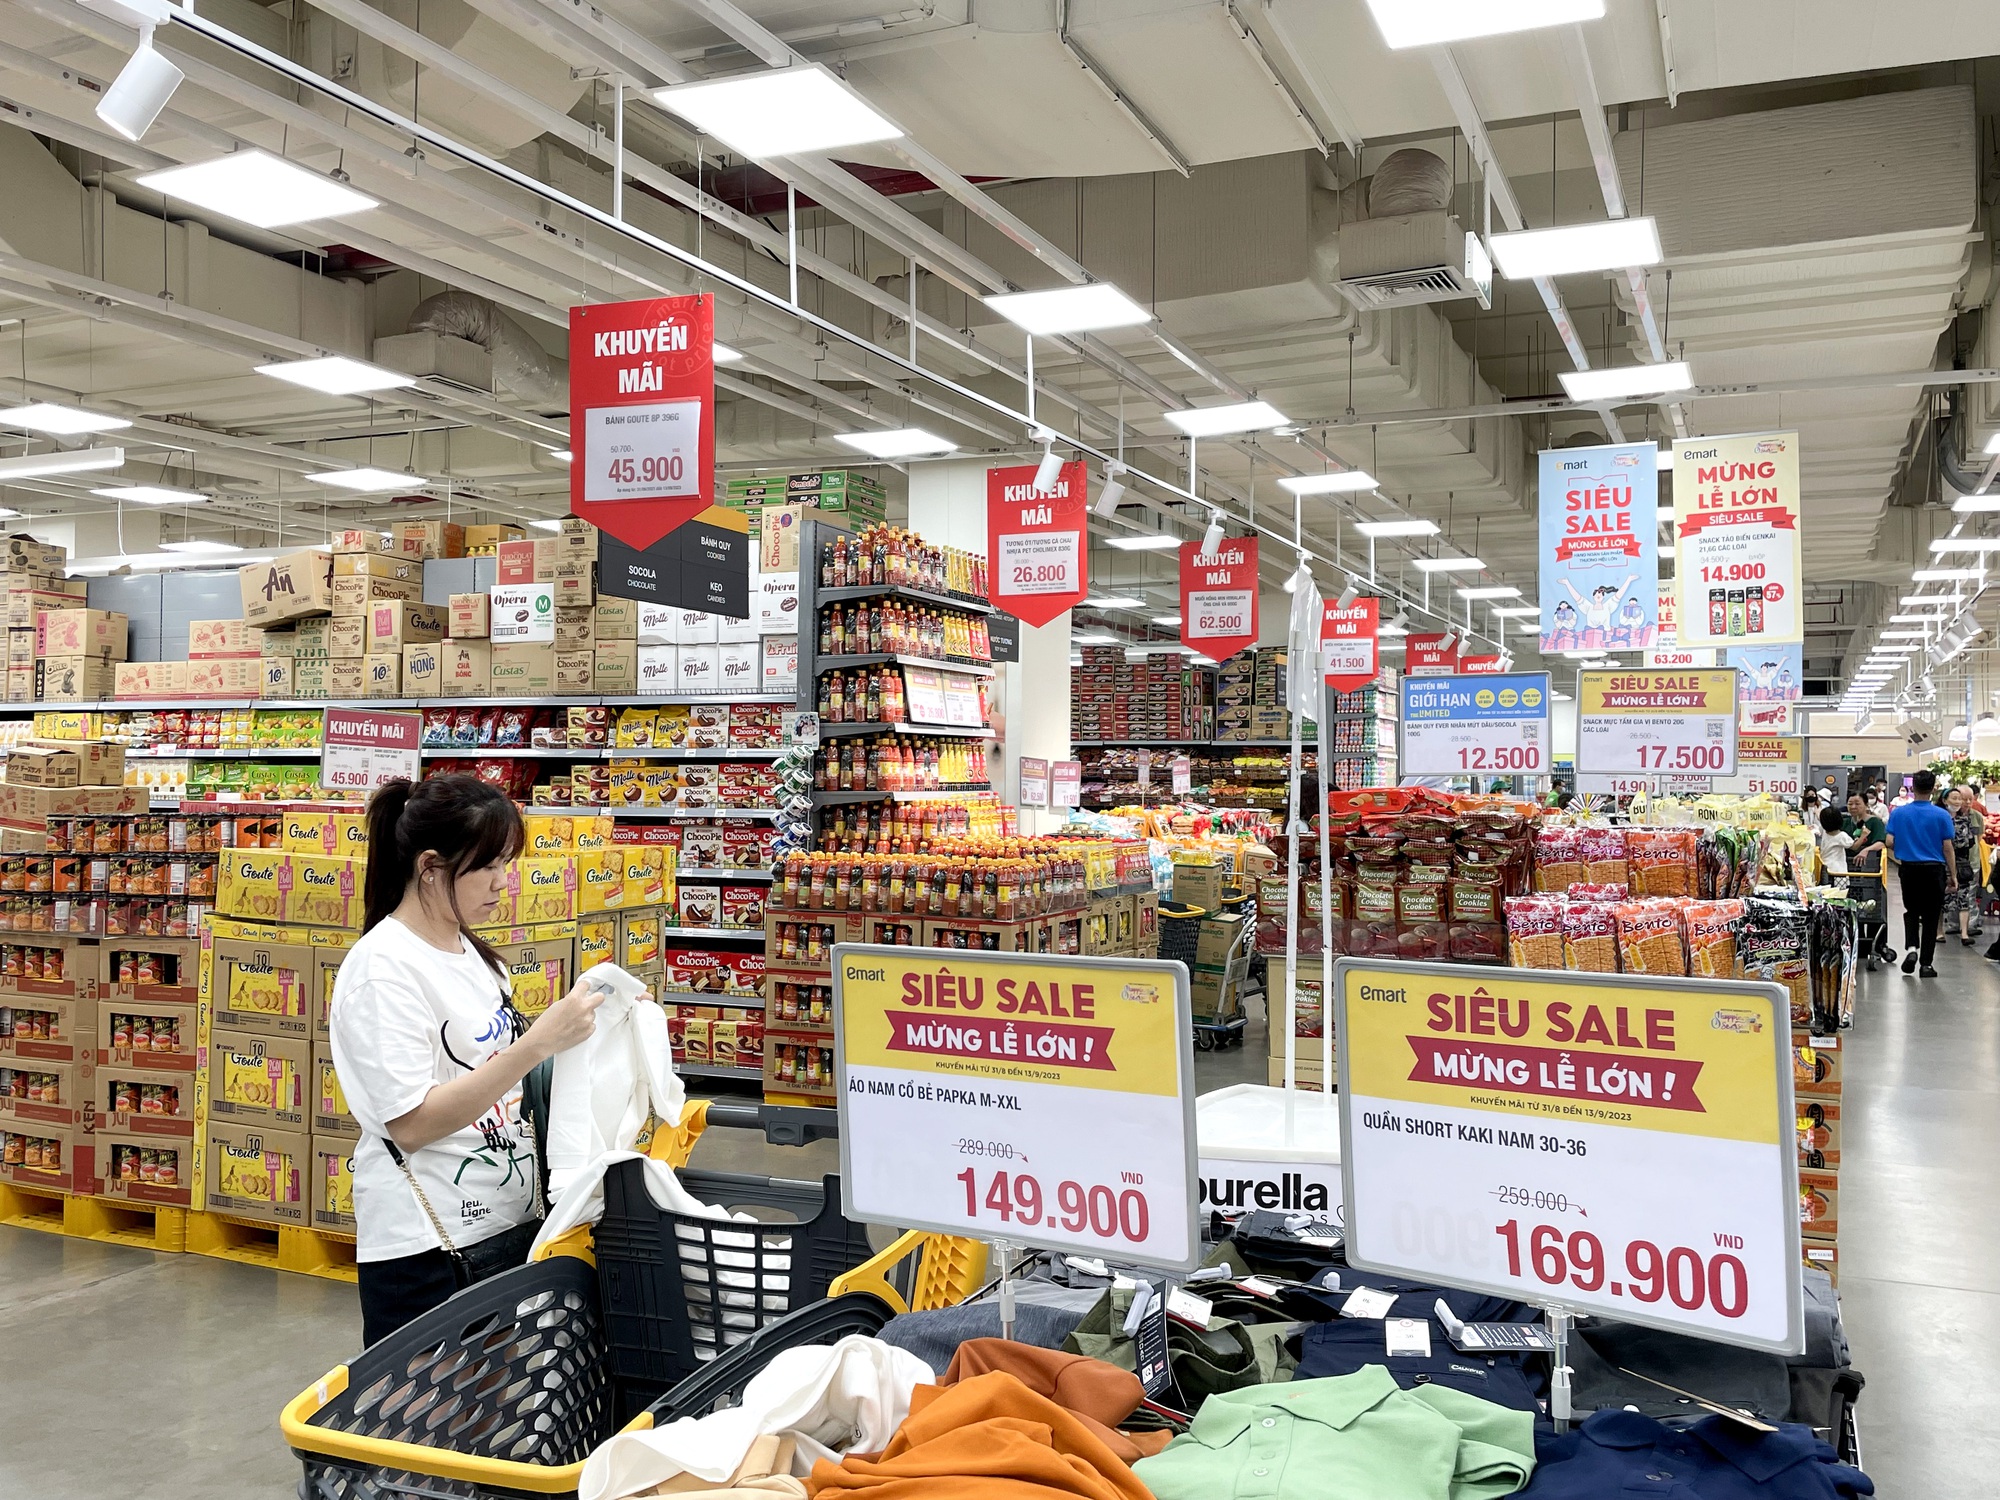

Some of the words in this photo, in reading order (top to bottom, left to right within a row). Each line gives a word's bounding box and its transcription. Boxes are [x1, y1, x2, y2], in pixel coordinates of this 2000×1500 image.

[594, 316, 688, 358] KHUYẾN
[618, 361, 663, 394] MÃI
[605, 414, 625, 425] BÁNH
[626, 414, 650, 424] GOUTE
[651, 414, 660, 422] 8P
[661, 412, 680, 422] 396G
[1684, 448, 1718, 460] emart
[608, 456, 683, 484] 45.900
[1556, 460, 1588, 470] emart
[1698, 461, 1776, 485] MỪNG
[1566, 484, 1632, 512] SIÊU
[1698, 485, 1724, 510] LỄ
[1731, 484, 1778, 507] LỚN
[1021, 504, 1052, 526] MÃI
[1709, 513, 1734, 525] SIÊU
[1736, 512, 1764, 523] SALE
[1566, 512, 1631, 534] SALE
[700, 536, 718, 550] BÁNH
[718, 540, 732, 552] QUY
[1568, 539, 1597, 550] MỪNG
[1598, 536, 1609, 548] LỄ
[1610, 536, 1629, 548] LỚN
[1698, 536, 1721, 544] SNACK
[1752, 532, 1776, 540] GENKAI
[1032, 546, 1057, 554] CHOLIMEX
[1716, 542, 1730, 551] CÁC
[706, 550, 726, 562] COOKIES
[1193, 548, 1244, 567] KHUYẾN
[628, 564, 656, 579] SOCOLA
[1013, 564, 1066, 583] 26.800
[1206, 568, 1231, 585] MÃI
[1700, 562, 1766, 582] 14.900
[261, 566, 296, 602] An
[628, 578, 656, 591] CHOCOLATE
[710, 581, 723, 594] KẸO
[538, 600, 548, 610] M
[706, 594, 726, 604] CANDIES
[598, 606, 624, 616] Custas
[1326, 606, 1368, 620] KHUYẾN
[556, 616, 588, 624] ChocoPie
[1200, 616, 1242, 629] 62.500
[1336, 622, 1357, 634] MÃI
[458, 650, 470, 660] An
[1424, 652, 1440, 663] MÃI
[1654, 654, 1692, 664] 63.200
[598, 662, 624, 672] Custas
[1330, 658, 1365, 668] 41.500
[493, 666, 524, 676] Custas
[1410, 680, 1436, 690] KHUYẾN
[1436, 681, 1450, 690] MÃI
[1610, 674, 1650, 690] SIÊU
[1654, 676, 1700, 690] SALE
[1440, 693, 1471, 709] HẠN
[1611, 694, 1648, 706] MỪNG
[1650, 692, 1665, 706] LỄ
[1666, 694, 1690, 706] LỚN
[1419, 710, 1450, 718] LIMITED
[1407, 722, 1422, 730] BÁNH
[1450, 720, 1466, 728] NHÂN
[1583, 718, 1603, 726] SNACK
[1604, 718, 1618, 726] MỰC
[330, 719, 379, 738] KHUYẾN
[382, 722, 404, 739] MÃI
[1738, 740, 1755, 749] IÊU
[1757, 741, 1784, 749] SALE
[1458, 746, 1540, 770] 12.500
[1636, 745, 1725, 770] 17.500
[1764, 750, 1778, 758] LỚN
[331, 772, 368, 786] 45.900
[1748, 780, 1798, 793] 51.500
[1632, 847, 1680, 860] Bento
[682, 892, 718, 902] ChocoPie
[1358, 892, 1393, 900] Chocolate
[1360, 898, 1389, 906] Cookies
[1401, 896, 1436, 904] Chocolate
[1454, 892, 1492, 901] Chocolate
[1404, 902, 1433, 912] Cookies
[1458, 898, 1488, 908] Cookies
[1512, 918, 1555, 932] Bento
[1622, 917, 1672, 934] Bento
[1749, 937, 1800, 950] Bento
[676, 954, 720, 966] ChocoPie
[846, 966, 886, 983] emart
[900, 966, 984, 1010] SIÊU
[996, 978, 1096, 1020] SALE
[1360, 984, 1408, 1004] emart
[1426, 986, 1530, 1037] SIÊU
[1546, 1001, 1676, 1052] SALE
[906, 1020, 982, 1052] MỪNG
[990, 1022, 1018, 1056] LỄ
[1025, 1028, 1077, 1060] LỚN
[252, 1044, 264, 1056] 10
[935, 1060, 962, 1070] KHUYẾN
[964, 1063, 979, 1072] MÃI
[980, 1062, 991, 1072] TỪ
[992, 1066, 1006, 1074] 31/8
[1007, 1065, 1023, 1078] ĐẾN
[1024, 1069, 1061, 1080] 13/9/2023
[1433, 1048, 1530, 1085] MỪNG
[1540, 1052, 1577, 1092] LỄ
[1586, 1060, 1653, 1098] LỚN
[849, 1075, 865, 1094] ÁO
[868, 1081, 896, 1097] NAM
[898, 1078, 915, 1100] CỔ
[917, 1082, 934, 1101] BẺ
[936, 1088, 977, 1106] PAPKA
[980, 1092, 1022, 1111] M-XXL
[1470, 1094, 1505, 1108] KHUYẾN
[1508, 1098, 1526, 1110] MÃI
[1528, 1098, 1540, 1111] TỪ
[1542, 1102, 1561, 1114] 31/8
[1562, 1103, 1584, 1117] ĐẾN
[1584, 1108, 1632, 1122] 13/9/2023
[83, 1100, 96, 1134] KEN
[1363, 1112, 1400, 1132] QUẦN
[1404, 1117, 1454, 1139] SHORT
[1457, 1123, 1494, 1145] KAKI
[1498, 1128, 1535, 1150] NAM
[1538, 1134, 1587, 1157] 30-36
[248, 1138, 260, 1150] 10
[958, 1138, 1014, 1160] 289.000
[1120, 1171, 1144, 1185] VND
[956, 1166, 1150, 1243] 149.900
[1498, 1184, 1568, 1213] 259.000
[1713, 1232, 1744, 1250] VND
[1494, 1218, 1749, 1318] 169.900
